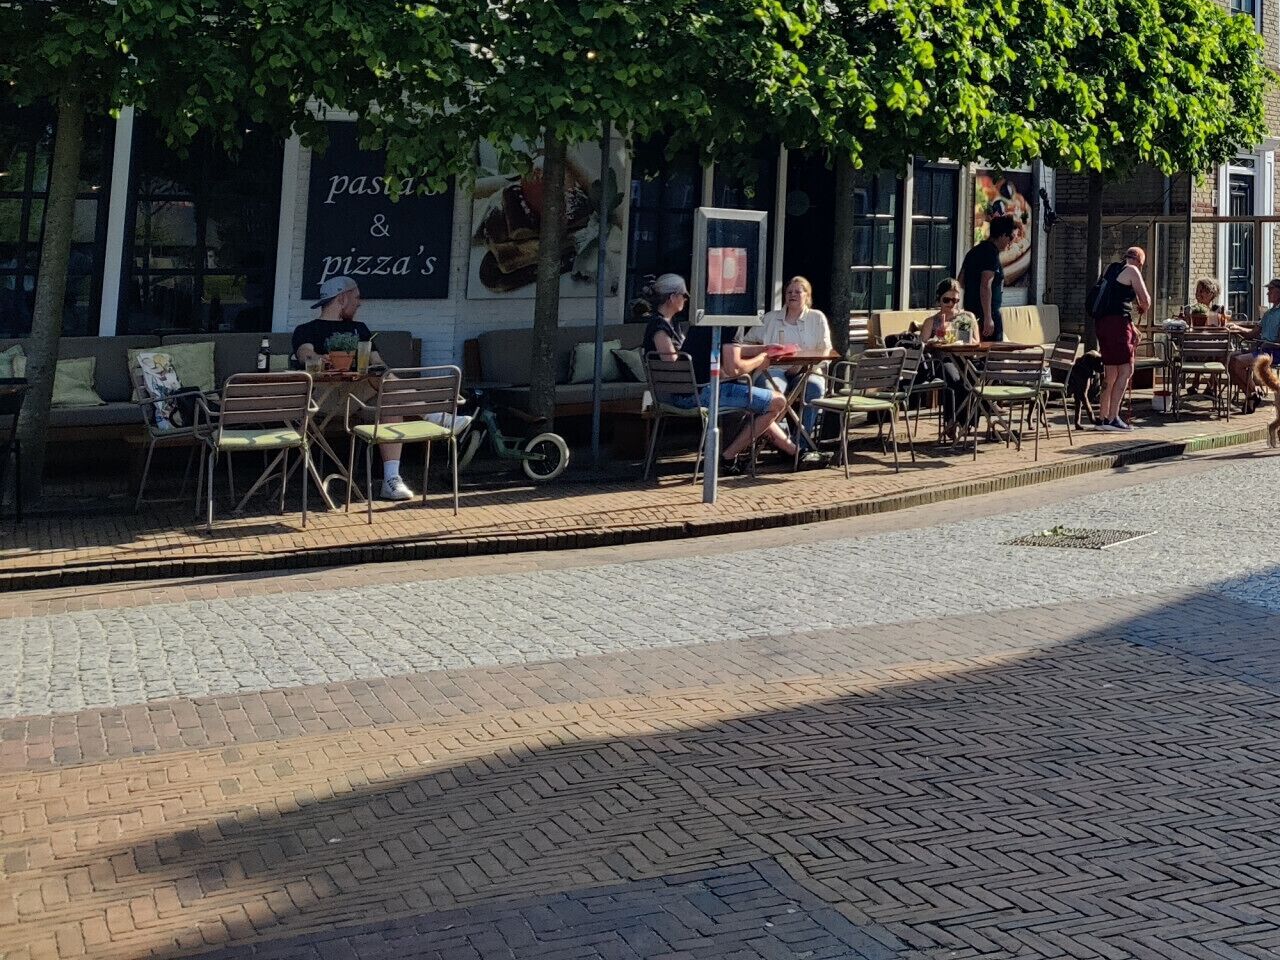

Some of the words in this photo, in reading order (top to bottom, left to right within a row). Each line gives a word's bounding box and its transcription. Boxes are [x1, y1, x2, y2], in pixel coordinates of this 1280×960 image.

[323, 166, 439, 204] pasta'
[369, 213, 391, 237] &
[316, 245, 438, 286] pizza's
